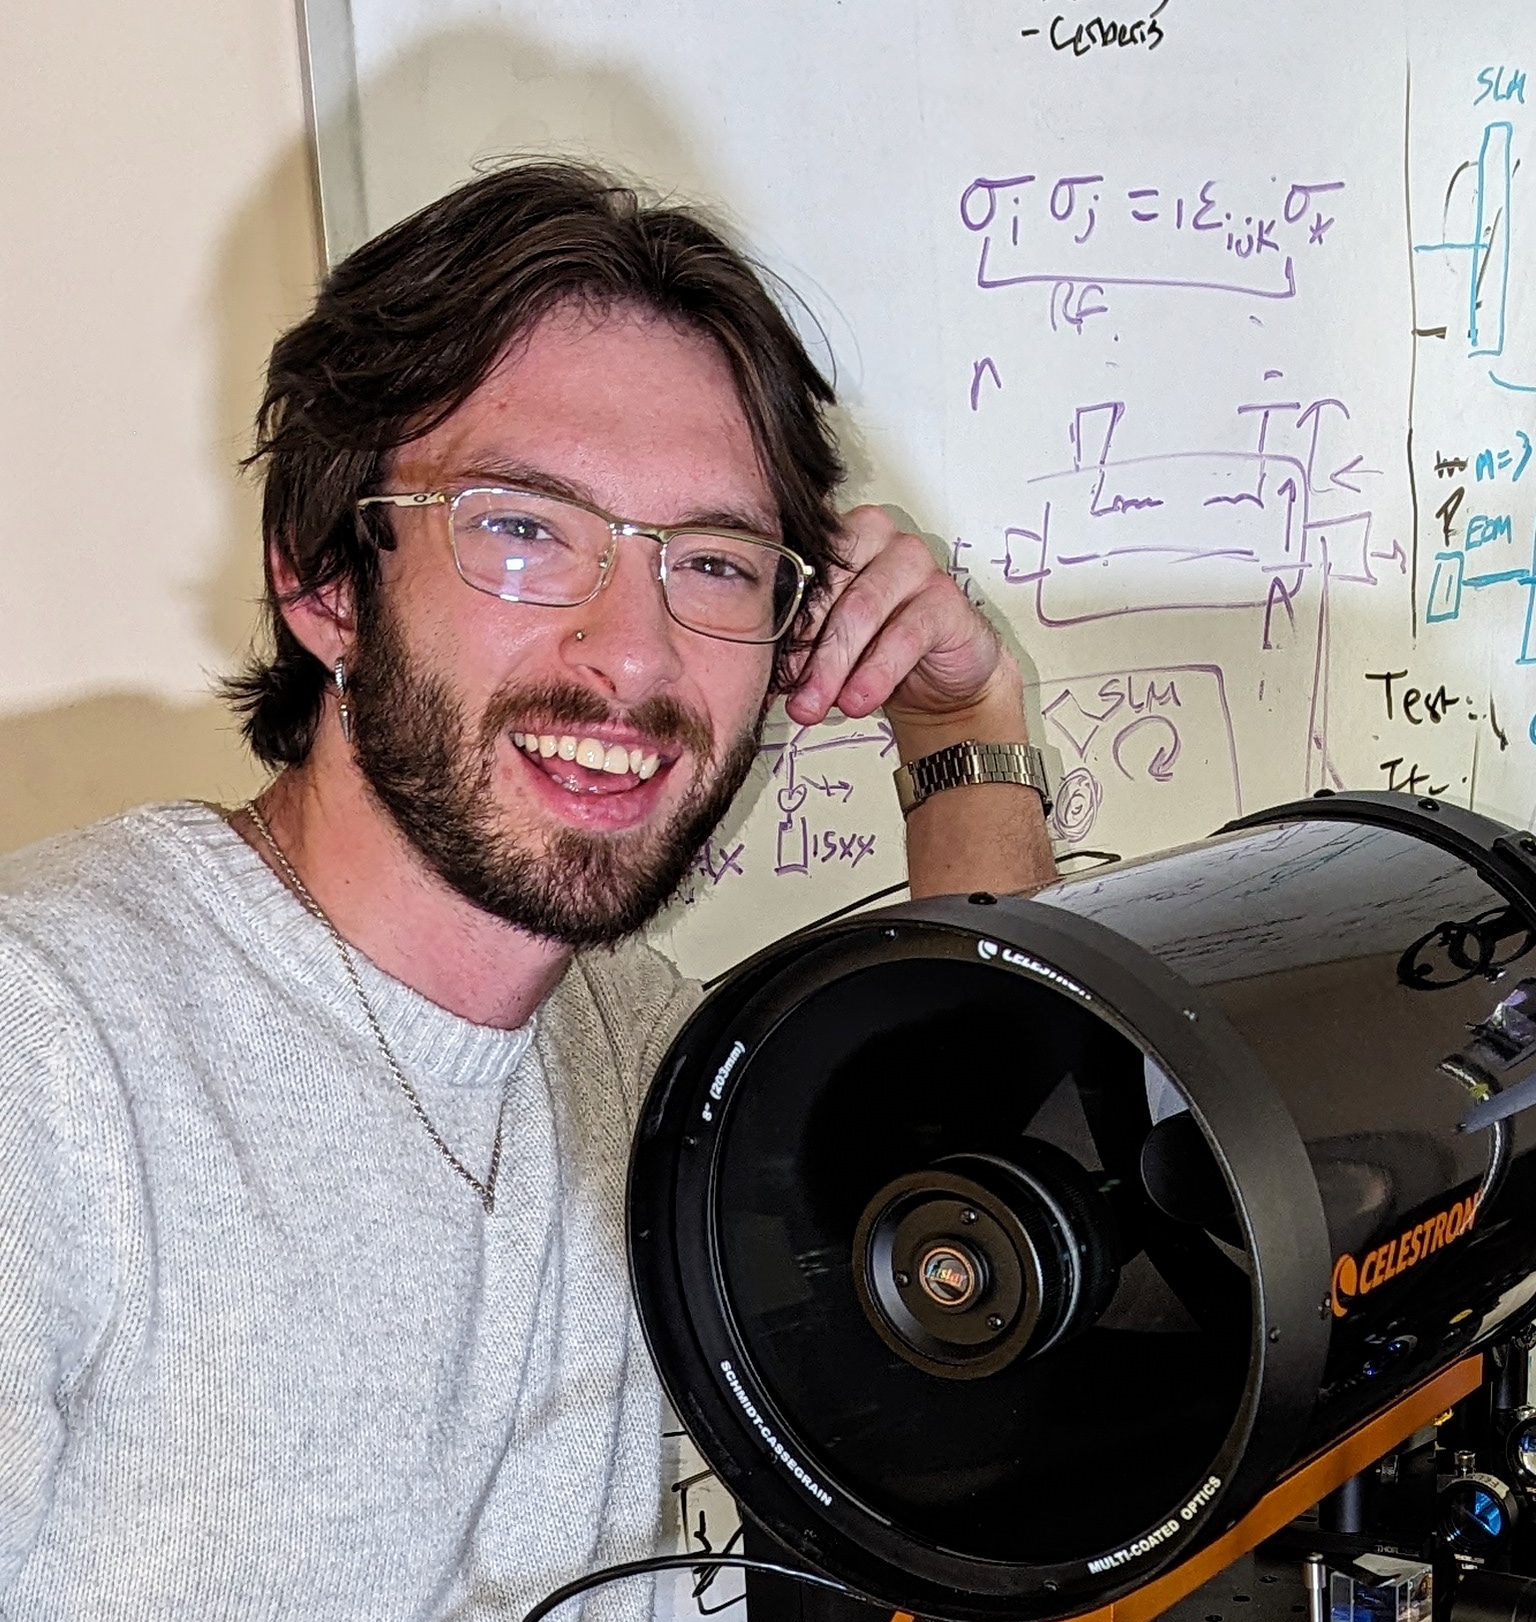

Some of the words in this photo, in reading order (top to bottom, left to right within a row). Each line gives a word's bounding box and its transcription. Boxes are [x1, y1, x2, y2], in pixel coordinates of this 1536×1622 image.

[1099, 677, 1182, 715] SLM
[1359, 1190, 1484, 1295] CELESTRON
[719, 1360, 833, 1507] SCHMIDT-CASSEGRAIN
[1086, 1519, 1181, 1575] MULTI-COATED
[1179, 1474, 1222, 1521] OPTICS
